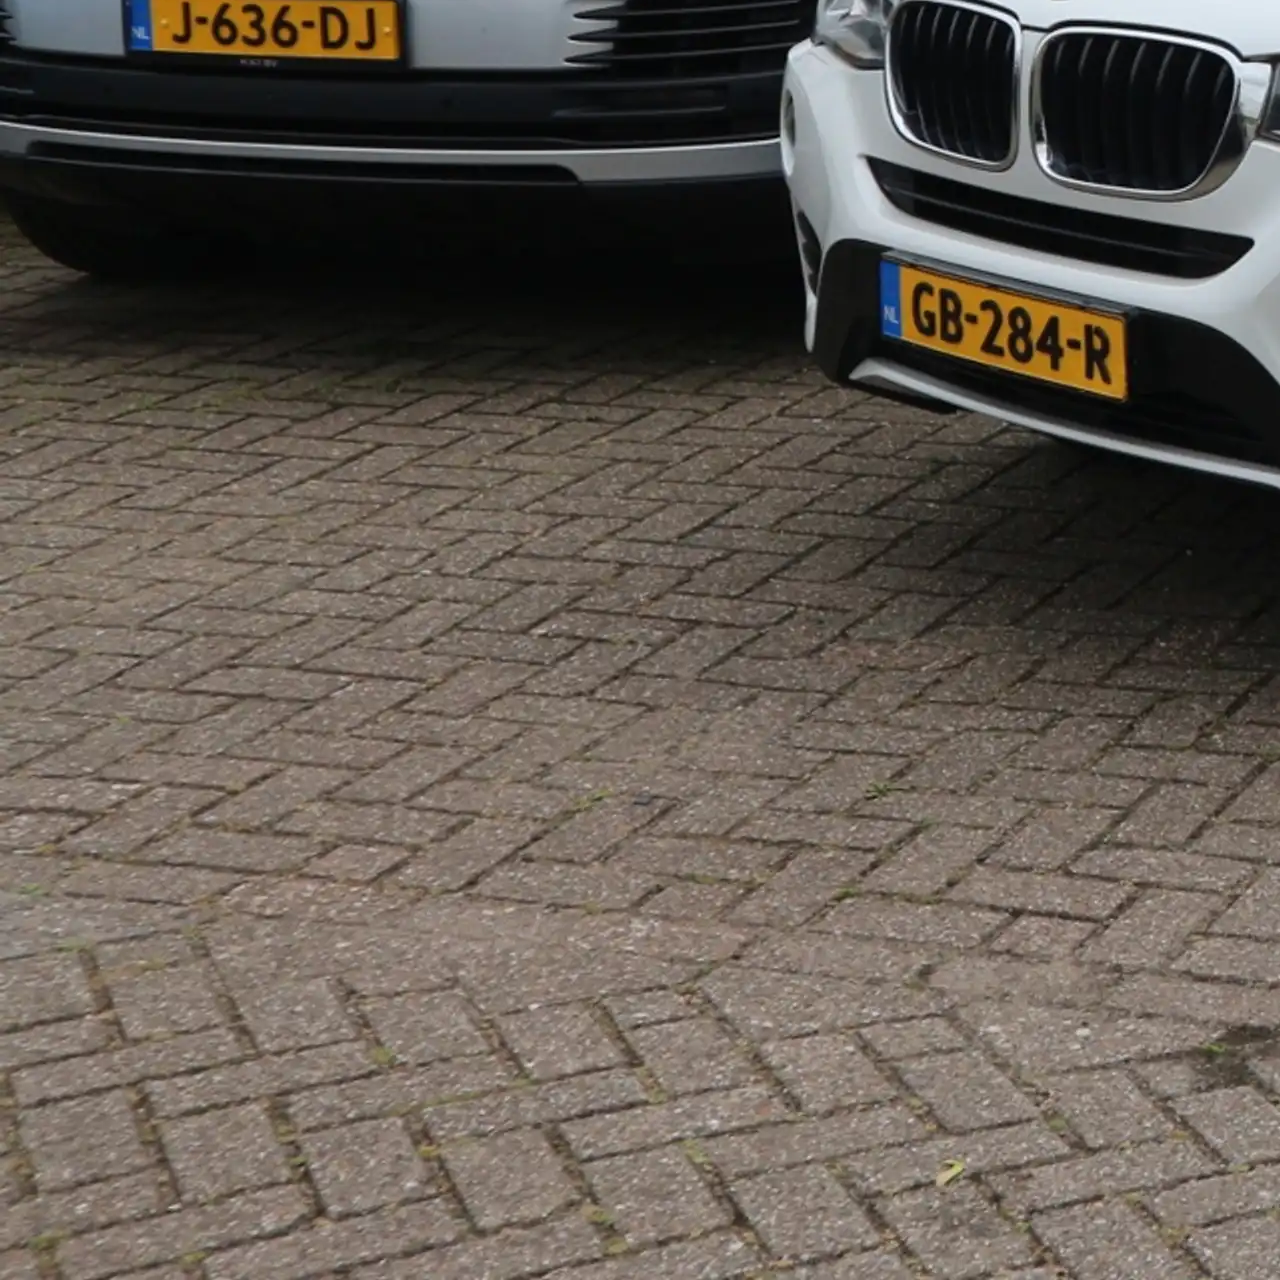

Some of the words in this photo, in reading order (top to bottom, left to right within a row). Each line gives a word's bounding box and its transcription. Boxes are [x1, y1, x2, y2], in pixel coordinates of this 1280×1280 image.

[131, 26, 150, 40] NL
[172, 1, 377, 51] J-636-DJ
[884, 304, 899, 325] NL
[911, 281, 1112, 385] GB-284-R
